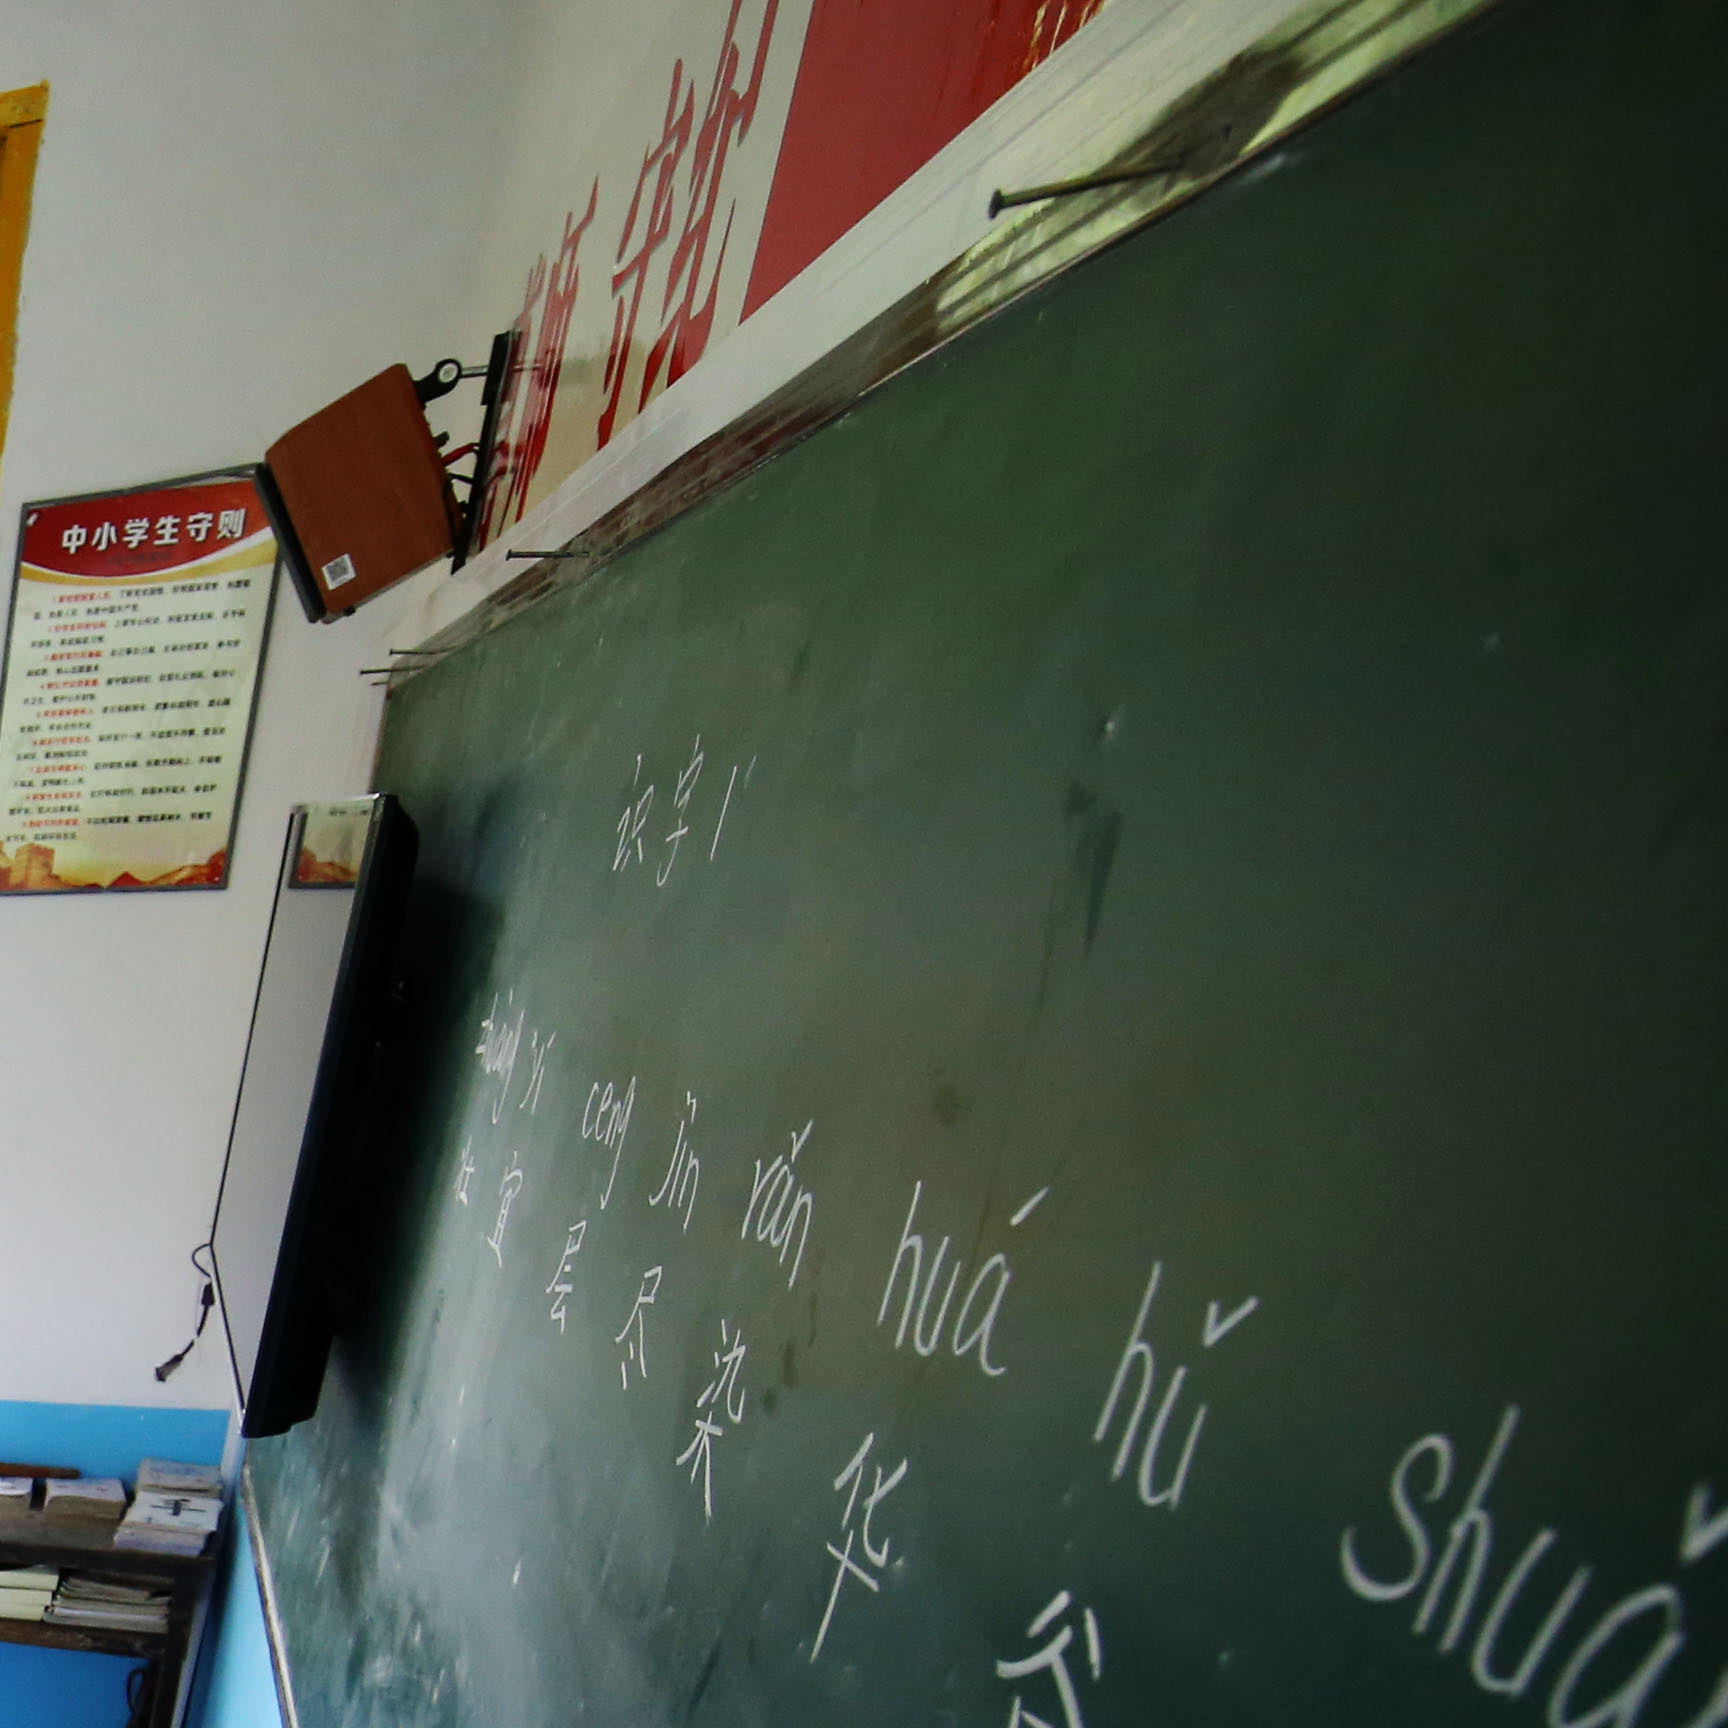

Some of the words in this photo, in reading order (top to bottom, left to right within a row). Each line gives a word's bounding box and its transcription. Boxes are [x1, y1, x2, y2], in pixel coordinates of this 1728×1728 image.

[61, 508, 246, 554] 中小学生守则
[877, 1179, 1049, 1376] huá
[615, 1266, 664, 1391] 尽
[810, 1430, 908, 1665] 华
